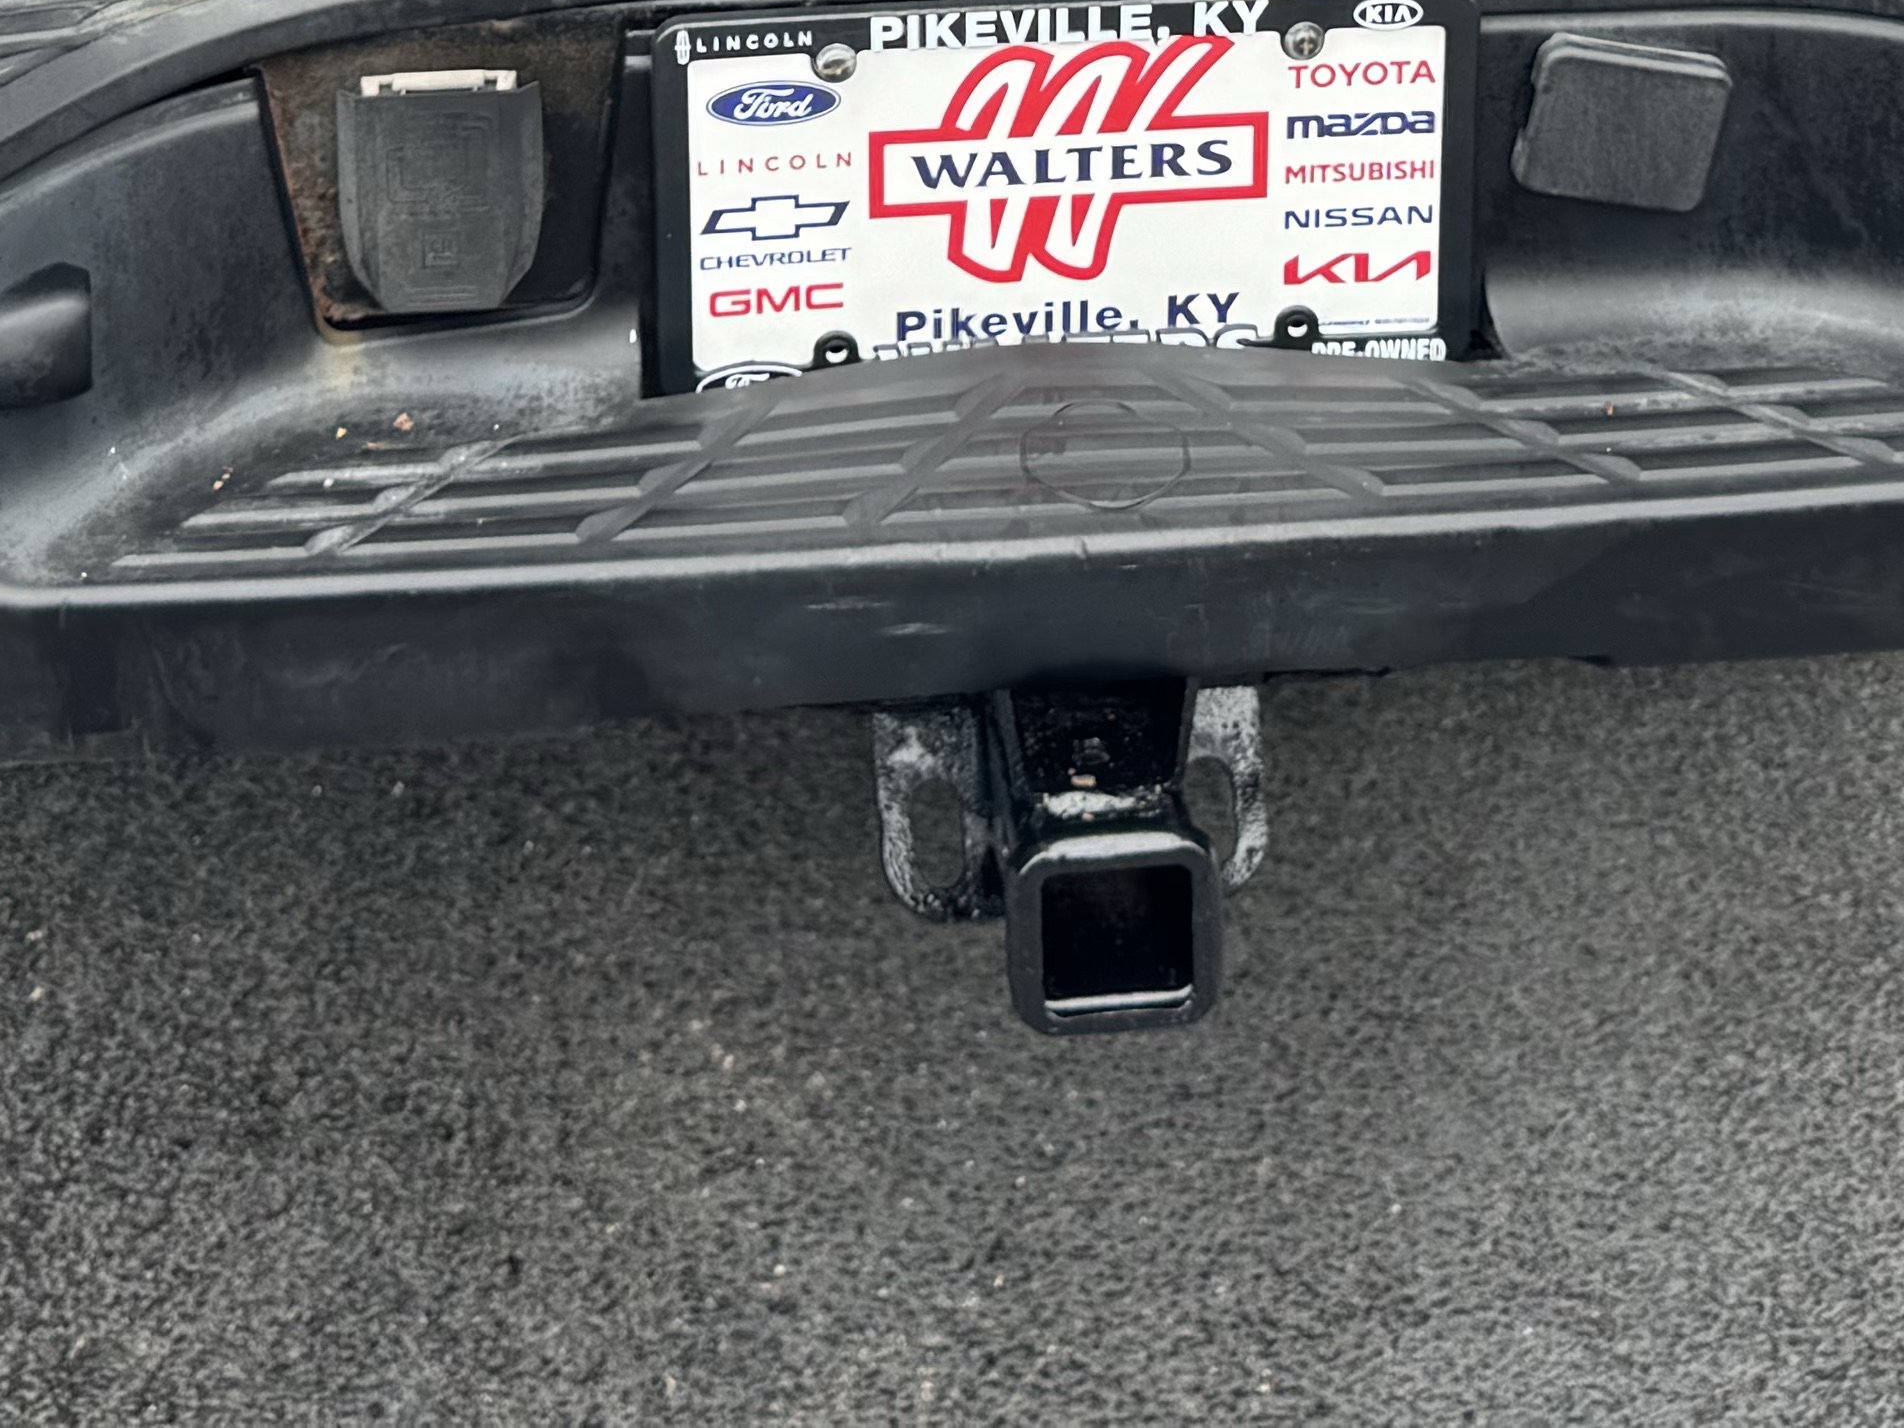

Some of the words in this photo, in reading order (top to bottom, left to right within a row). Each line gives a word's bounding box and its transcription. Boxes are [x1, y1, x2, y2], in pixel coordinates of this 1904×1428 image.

[869, 3, 1171, 52] PIKEVILLE,
[1194, 0, 1270, 37] KY
[1364, 4, 1413, 24] KIA
[696, 30, 813, 53] LINCOLN
[1288, 60, 1436, 89] TOYOTA
[733, 87, 814, 120] Ford
[697, 151, 852, 176] LINCOLN
[911, 140, 1233, 190] WALTERS
[1285, 160, 1435, 185] MITSUBISHI
[1284, 204, 1433, 230] NISSAN
[700, 247, 852, 271] CHEVROLET
[1284, 250, 1431, 285] KIA
[709, 282, 844, 318] GMC
[1167, 292, 1240, 327] KY
